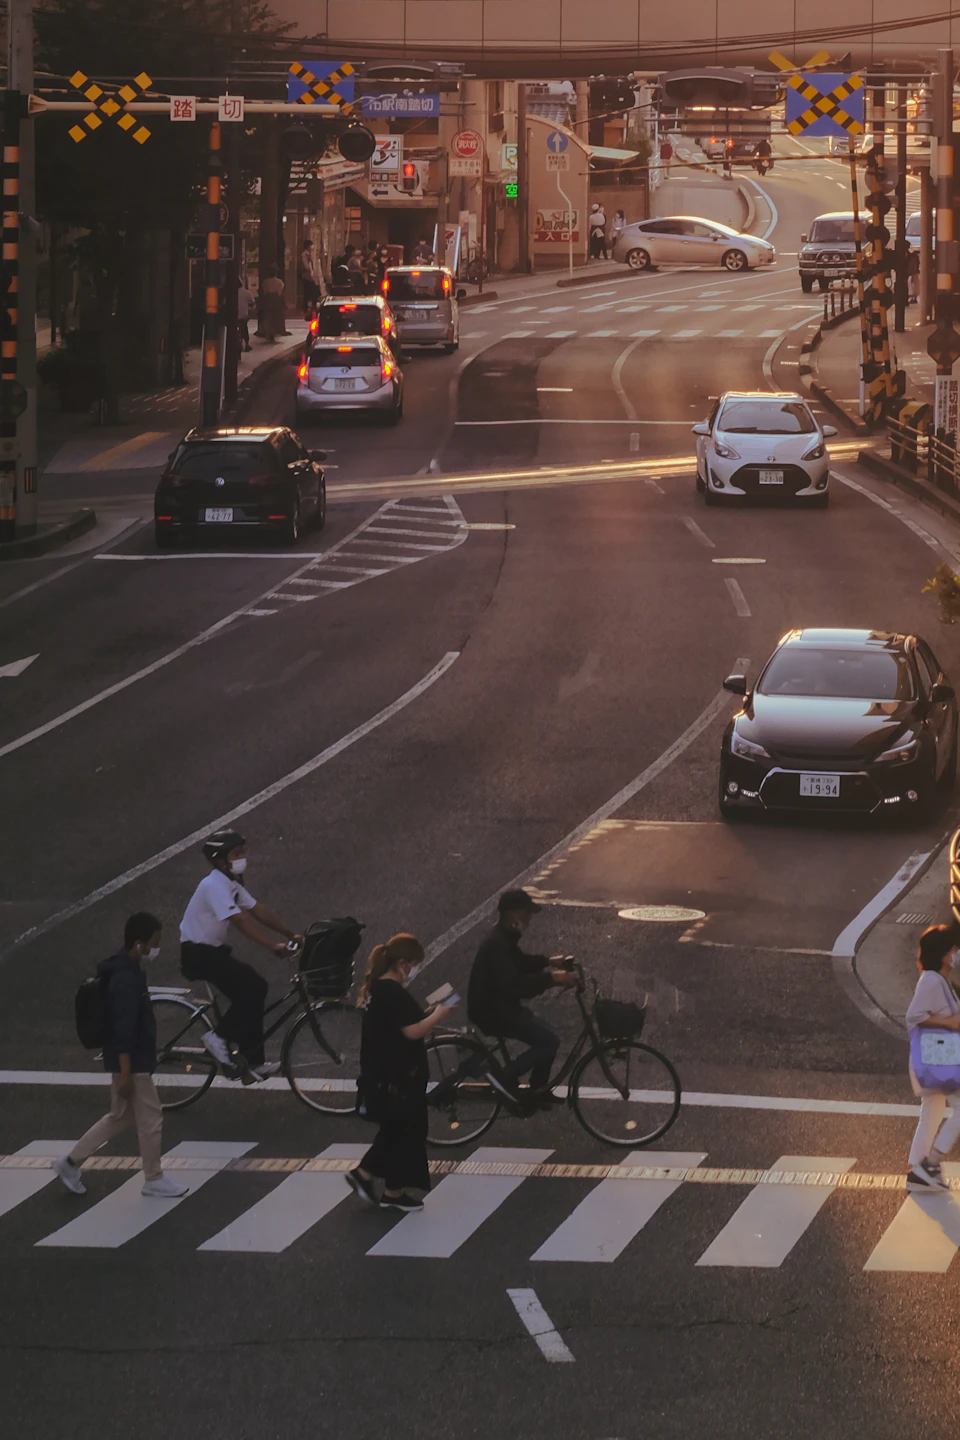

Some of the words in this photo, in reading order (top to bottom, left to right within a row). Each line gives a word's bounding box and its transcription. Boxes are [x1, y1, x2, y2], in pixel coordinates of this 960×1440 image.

[458, 139, 478, 149] 消火栓
[506, 184, 518, 197] 空
[545, 232, 570, 241] 入口
[810, 784, 837, 796] 19-94
